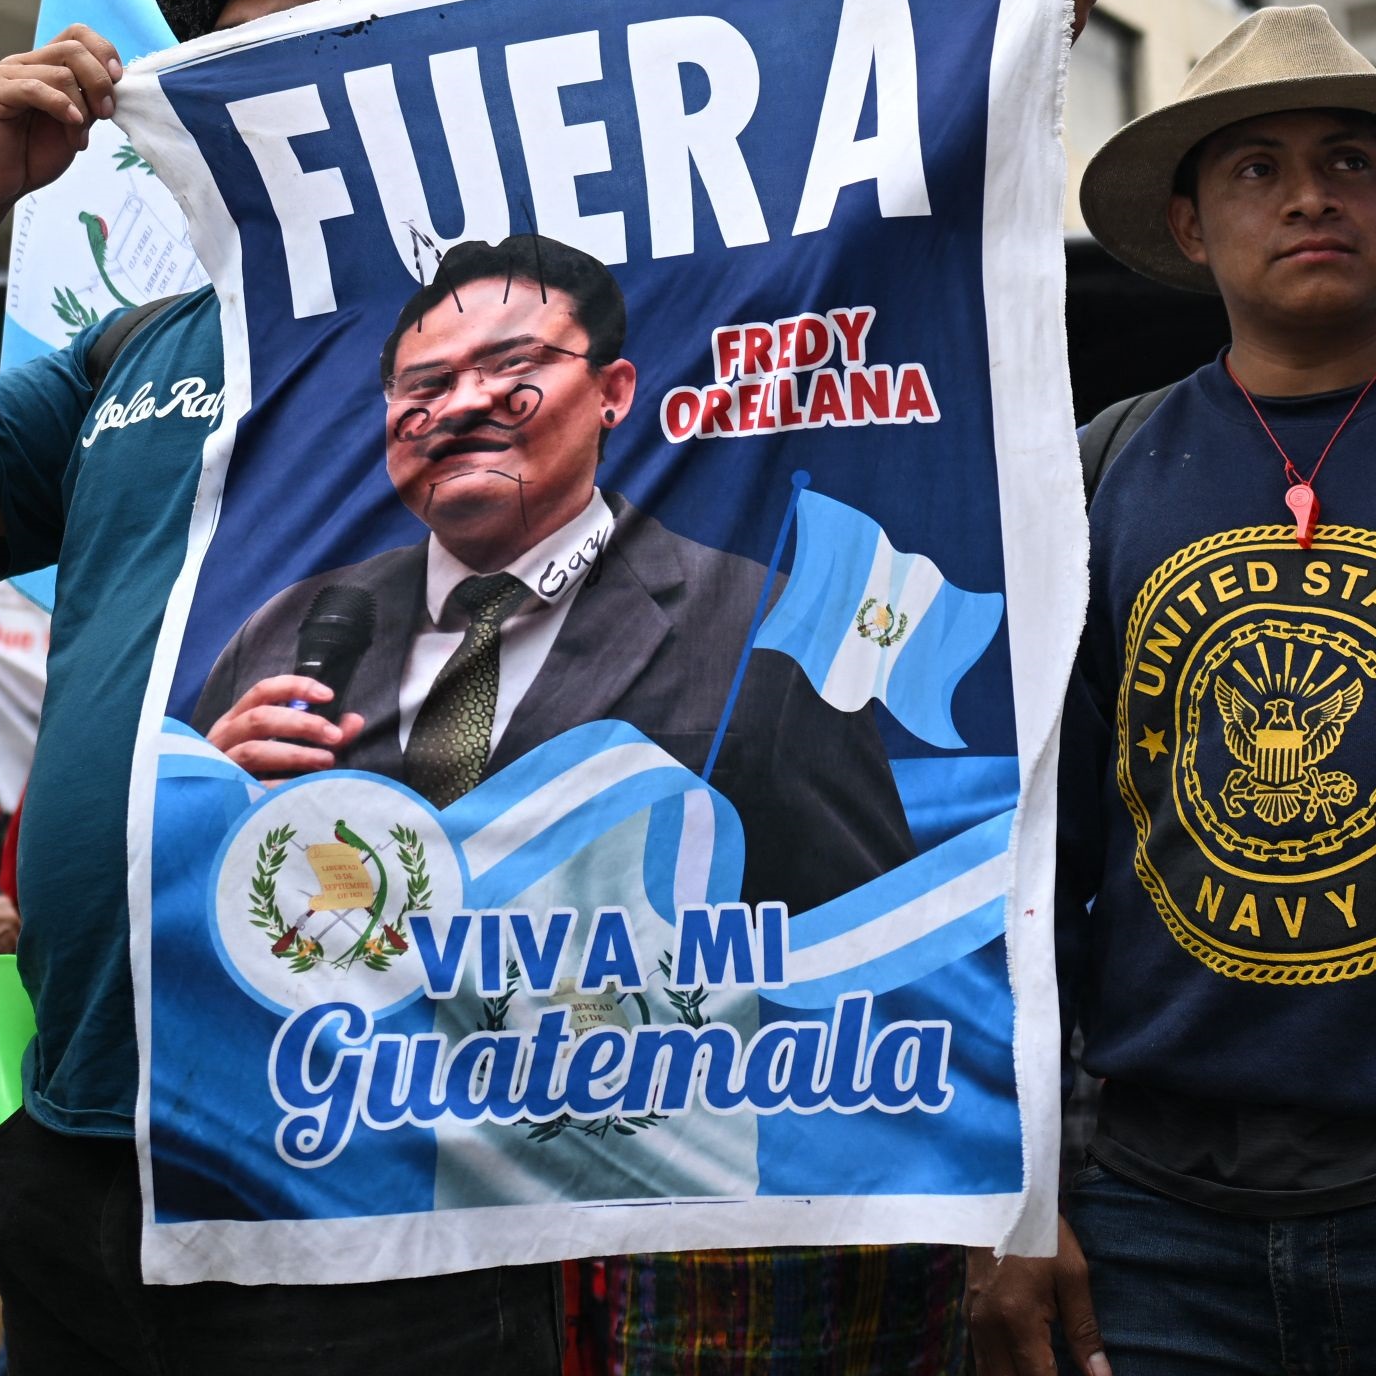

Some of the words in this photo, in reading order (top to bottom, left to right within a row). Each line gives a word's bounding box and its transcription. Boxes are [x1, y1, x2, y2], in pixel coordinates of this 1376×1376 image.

[717, 310, 873, 378] FREDY
[665, 369, 936, 437] ORELLANA
[1134, 561, 1278, 697] UNITED
[1196, 875, 1357, 938] NAVY
[408, 912, 641, 993] VIVA
[675, 907, 784, 985] MI
[577, 1014, 587, 1023] 15
[589, 1014, 606, 1023] DE
[274, 994, 949, 1165] Guatemala
